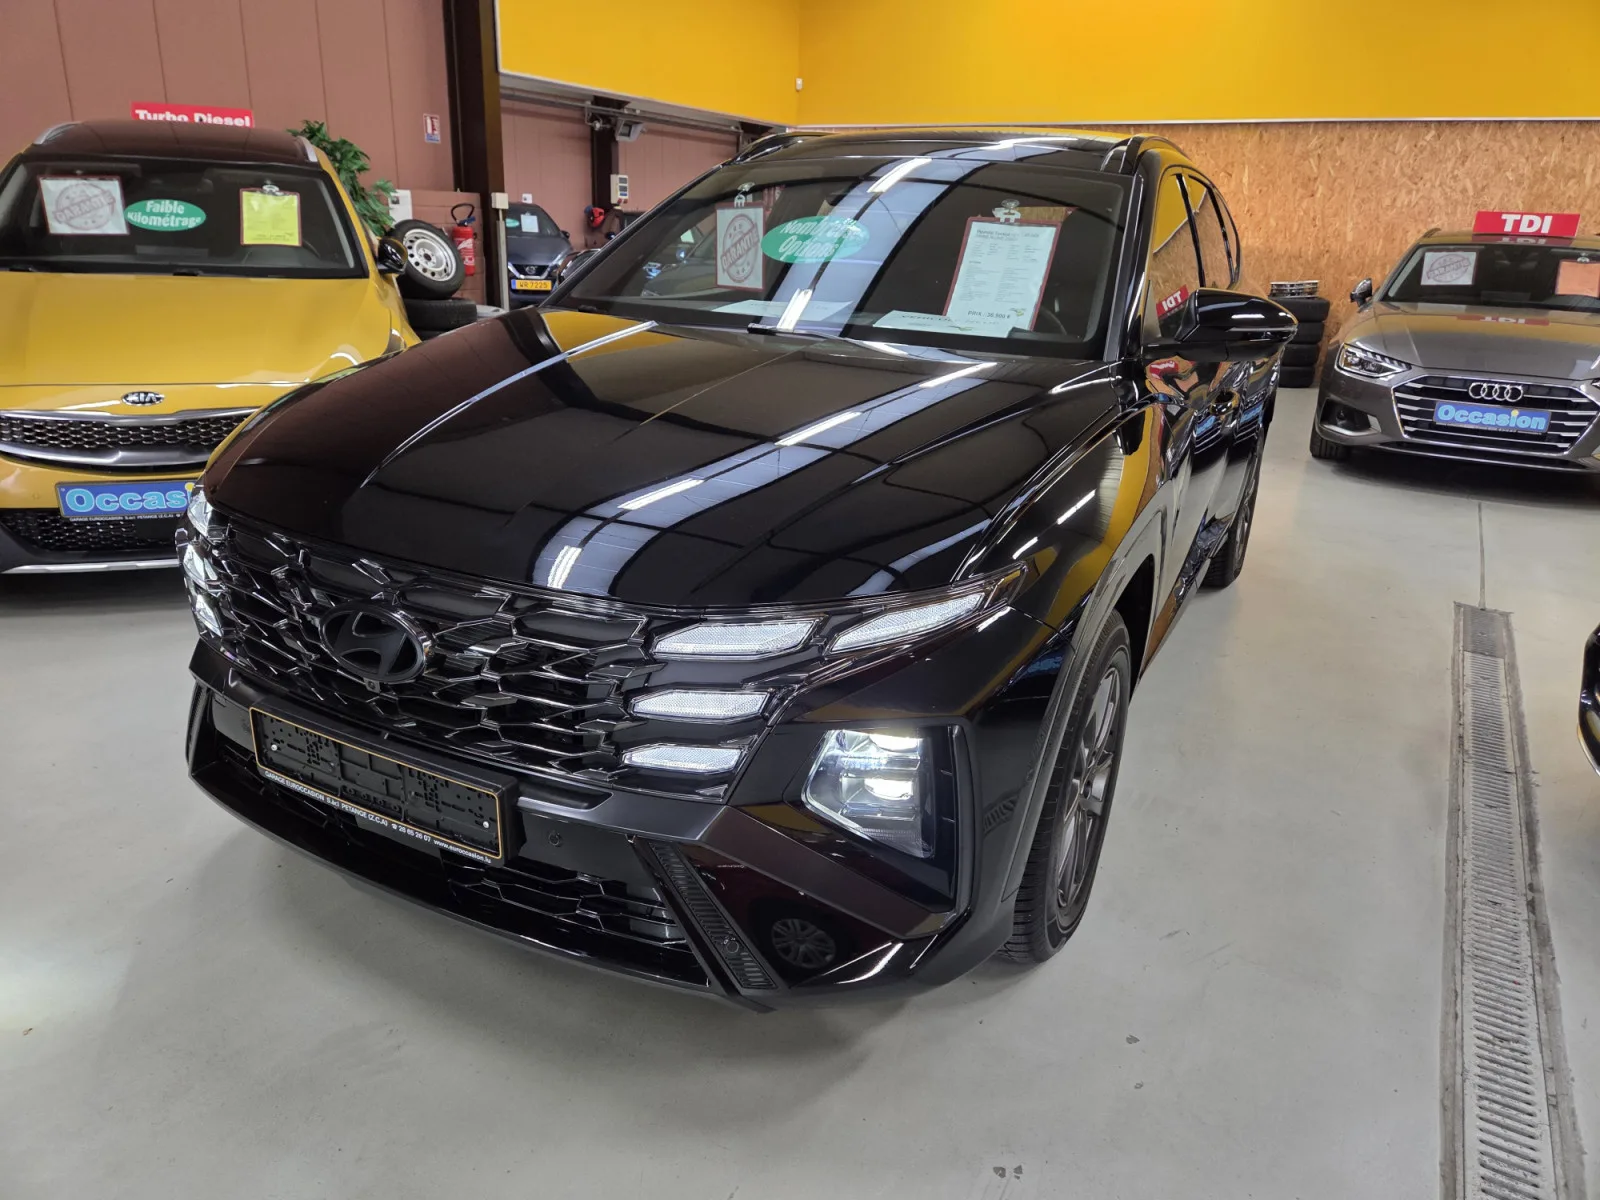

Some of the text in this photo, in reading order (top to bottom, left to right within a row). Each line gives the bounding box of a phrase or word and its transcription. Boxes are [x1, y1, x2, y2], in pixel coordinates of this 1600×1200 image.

[135, 109, 251, 127] Turbo Diesel
[145, 200, 185, 214] Faible
[1501, 213, 1553, 234] TDI
[778, 235, 840, 261] Options
[126, 392, 157, 403] KIA
[1437, 404, 1547, 430] Occasion
